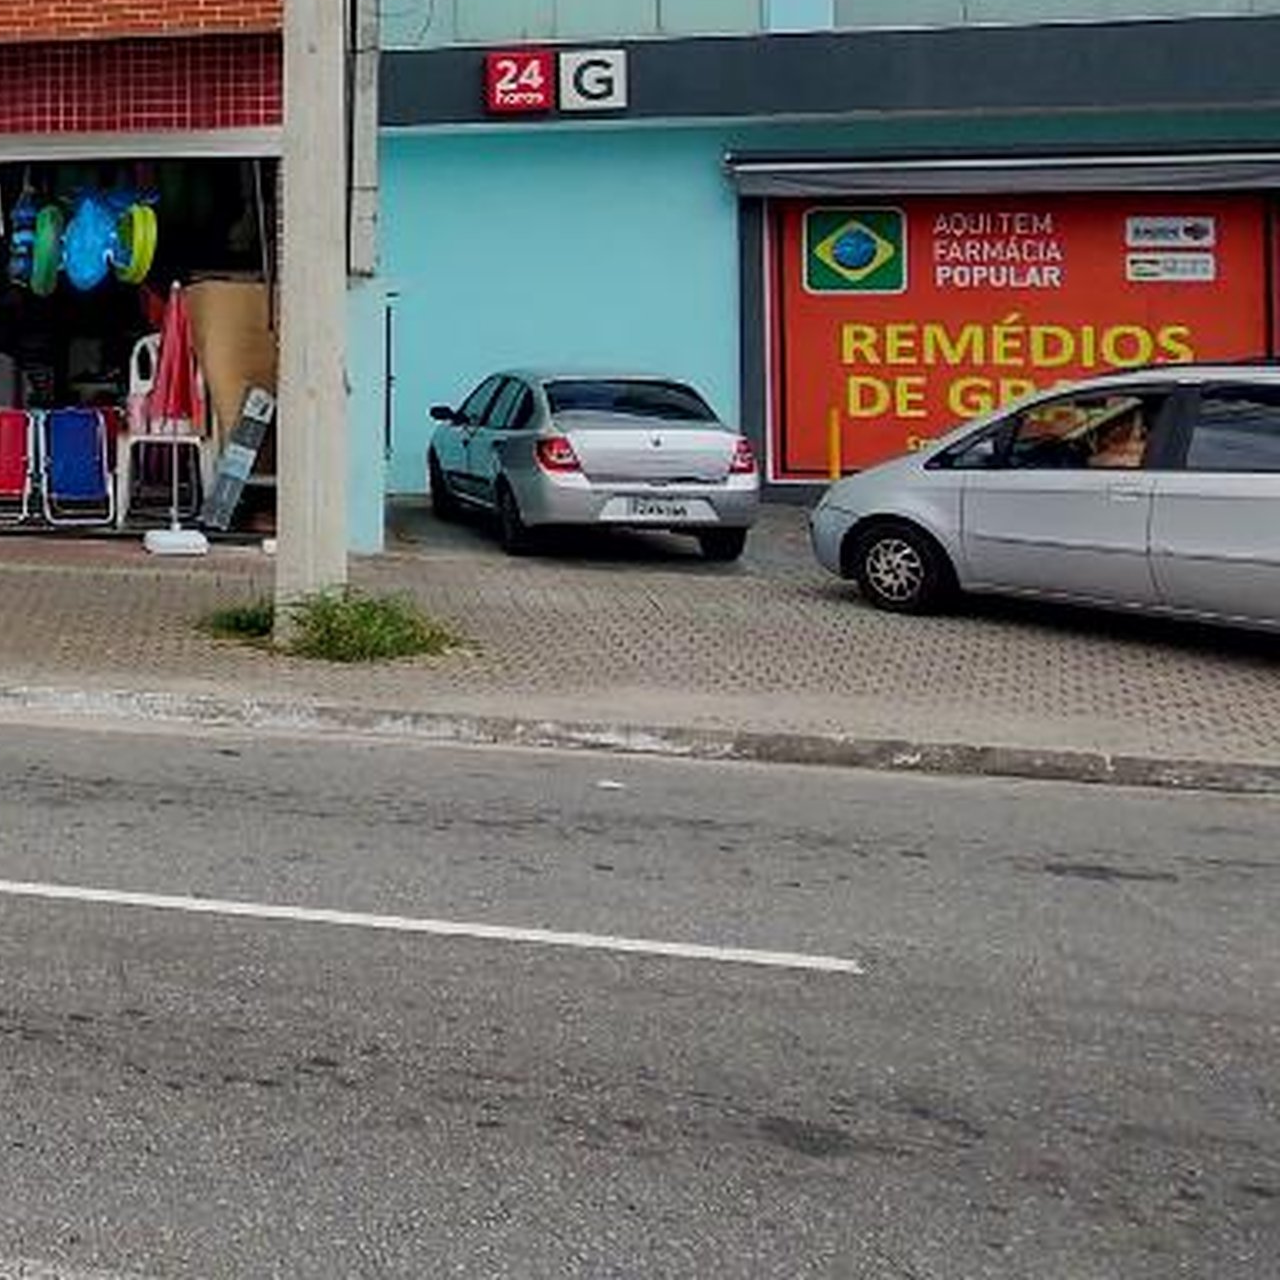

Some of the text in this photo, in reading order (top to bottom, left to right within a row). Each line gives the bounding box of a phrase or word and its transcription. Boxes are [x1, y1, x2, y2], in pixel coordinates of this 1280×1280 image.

[495, 58, 545, 91] 24
[573, 58, 614, 101] G
[933, 212, 1052, 235] AQUI TEM
[934, 236, 1062, 262] FARMÁCIA
[936, 265, 1061, 287] POPULAR
[841, 312, 1193, 367] REMÉDIOS
[846, 375, 928, 418] DE
